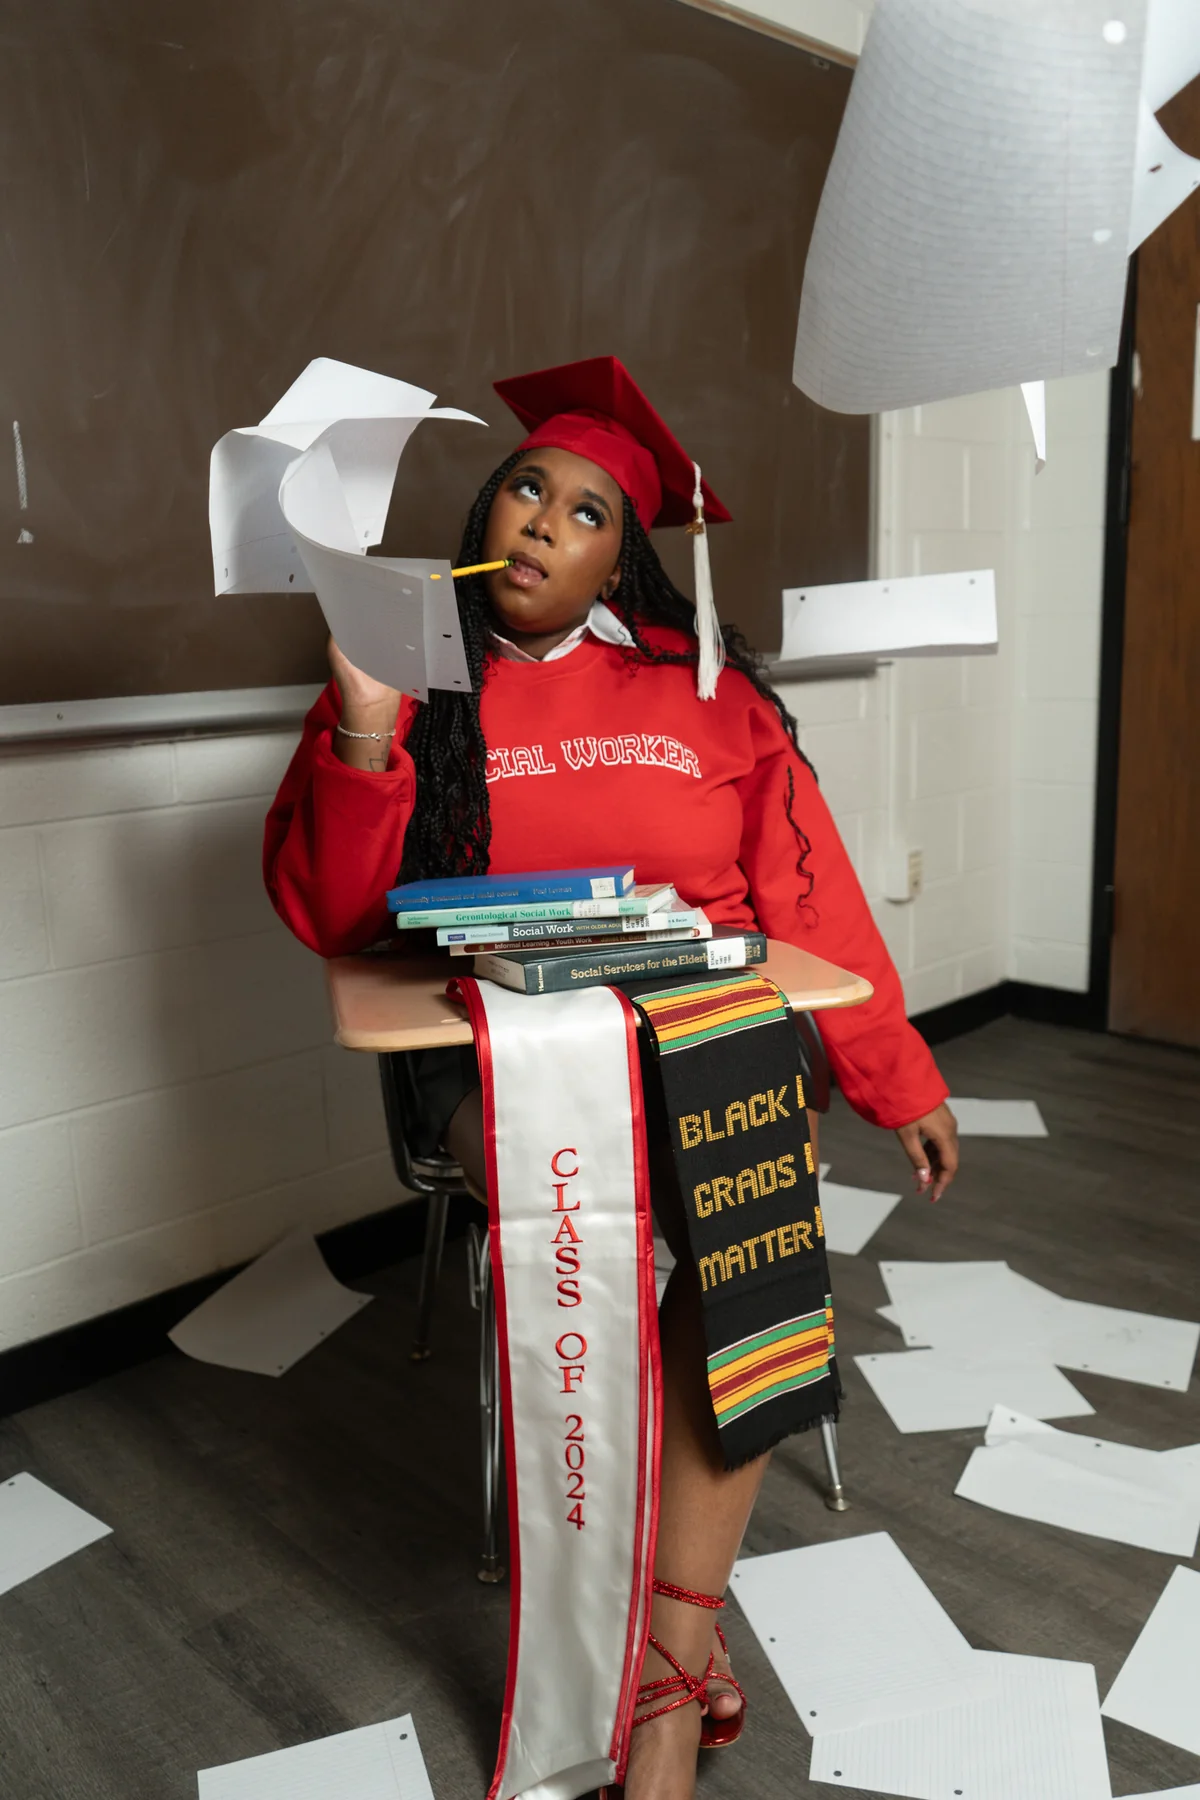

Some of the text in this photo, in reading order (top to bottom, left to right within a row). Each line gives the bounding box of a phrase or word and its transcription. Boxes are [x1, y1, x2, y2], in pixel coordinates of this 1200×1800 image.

[485, 733, 702, 783] CIAL WORKER
[455, 909, 518, 921] Gerontological
[520, 908, 546, 919] Social
[548, 907, 572, 917] Work
[513, 925, 545, 937] Social
[546, 923, 575, 935] Work
[494, 941, 521, 950] Informal
[522, 940, 550, 949] Learning
[556, 937, 575, 946] Youth
[575, 936, 593, 945] Work
[570, 965, 603, 980] Social
[603, 962, 646, 976] Services
[646, 959, 661, 970] for
[661, 957, 678, 968] the
[678, 1084, 790, 1150] BLACK
[693, 1153, 797, 1219] GRADS
[698, 1219, 815, 1292] MATTER
[549, 1147, 588, 1531] CLASS OF 2024
